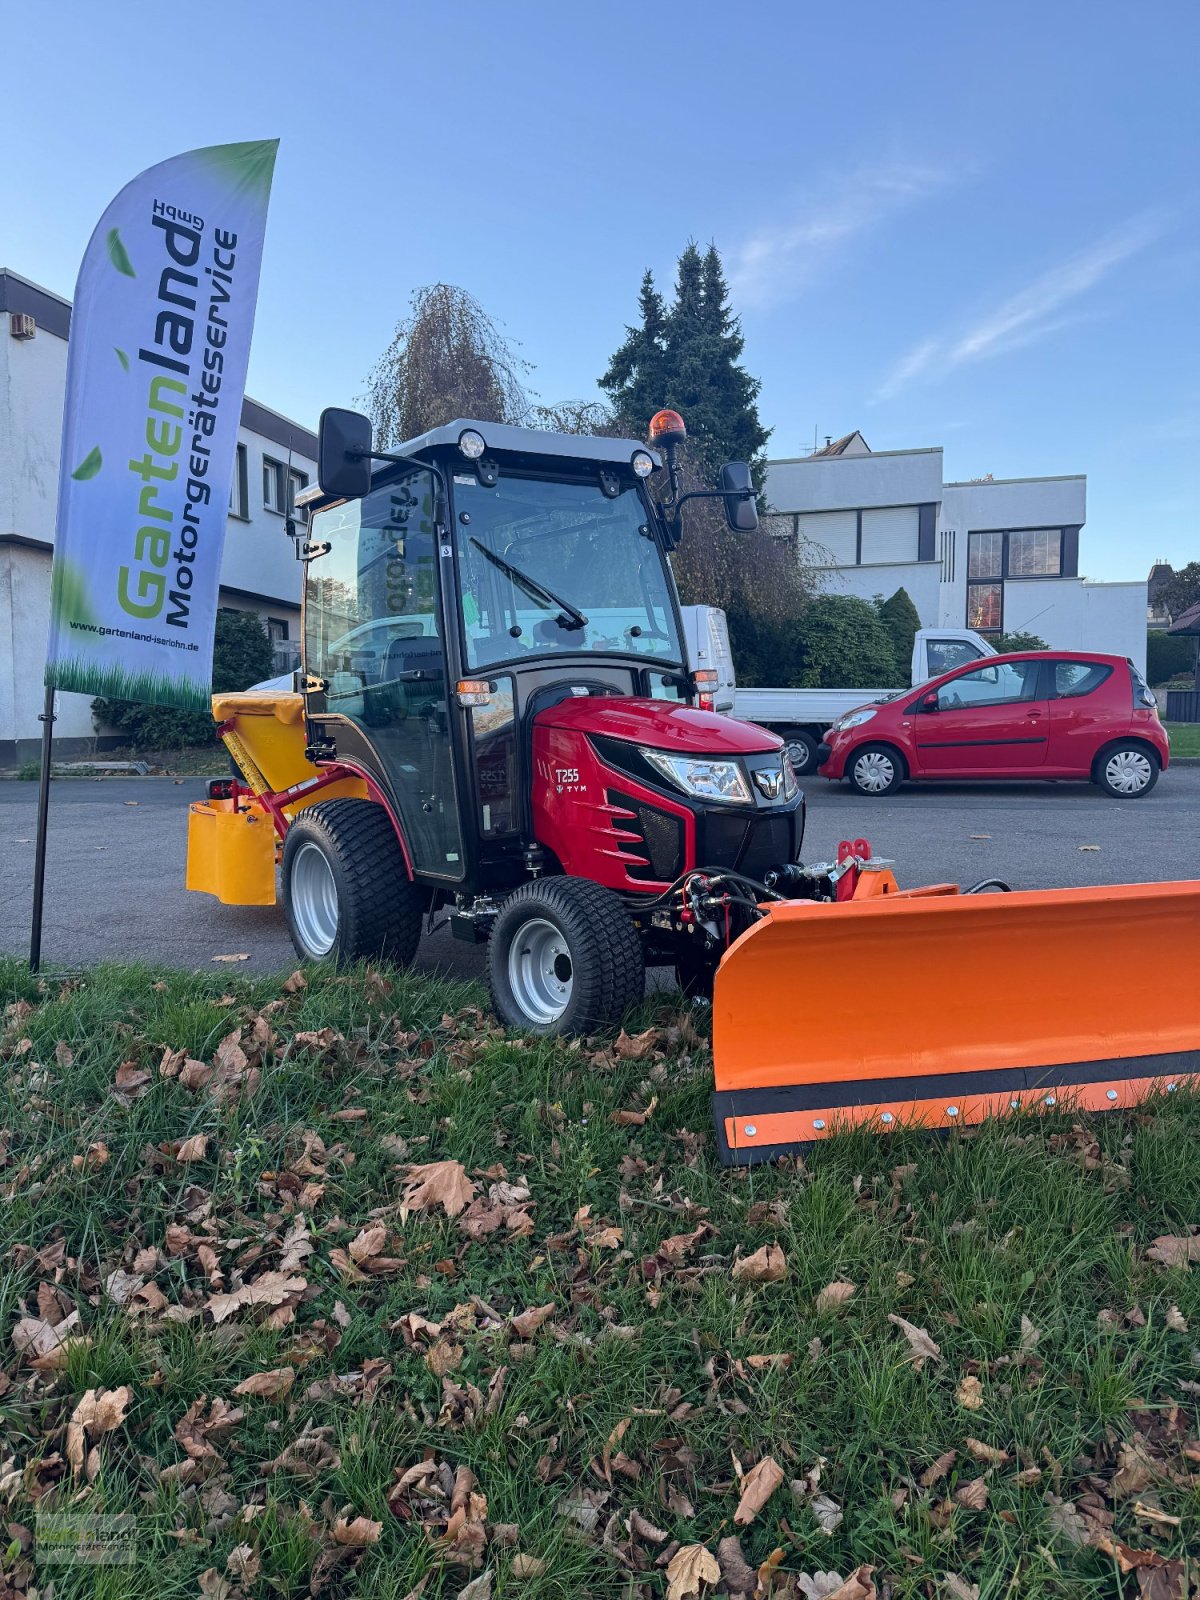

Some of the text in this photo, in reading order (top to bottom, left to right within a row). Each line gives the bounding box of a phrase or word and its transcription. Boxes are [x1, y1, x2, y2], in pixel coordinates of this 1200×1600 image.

[153, 199, 204, 231] GmbH
[118, 214, 201, 619] Gartenland
[166, 228, 237, 628] Motorgeräteservice
[70, 621, 199, 651] www.gartenland-iserlohn.de
[555, 769, 579, 783] T255
